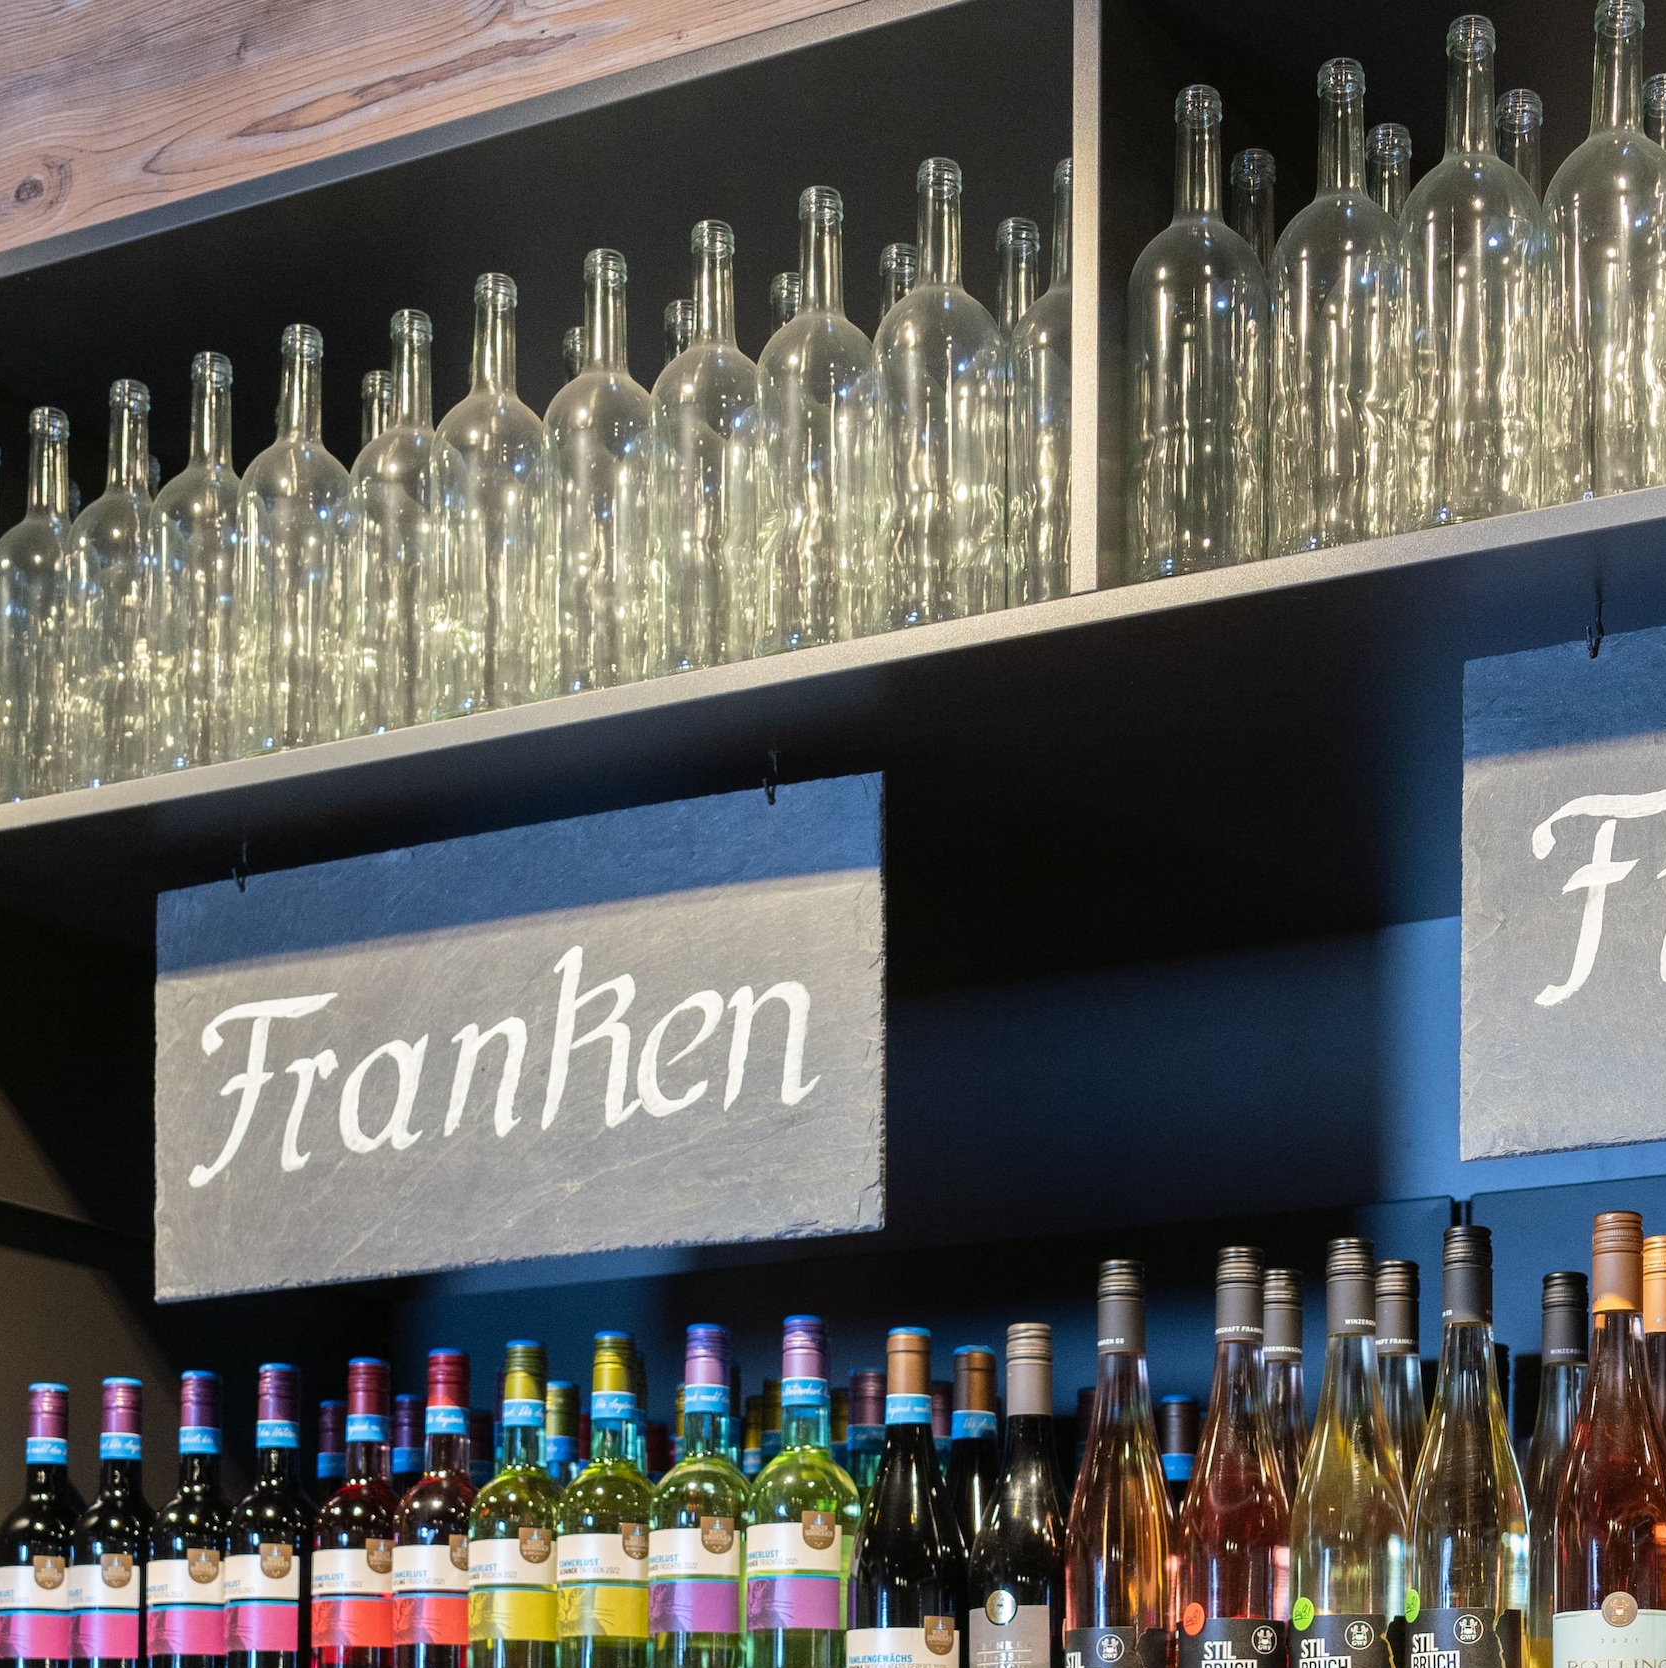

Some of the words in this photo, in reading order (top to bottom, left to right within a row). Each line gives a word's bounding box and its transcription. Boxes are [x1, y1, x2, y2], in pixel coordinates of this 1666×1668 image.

[188, 945, 821, 1188] Franken
[1203, 1640, 1234, 1661] STIL
[1301, 1637, 1330, 1657] STIL
[1413, 1633, 1439, 1655] STIL
